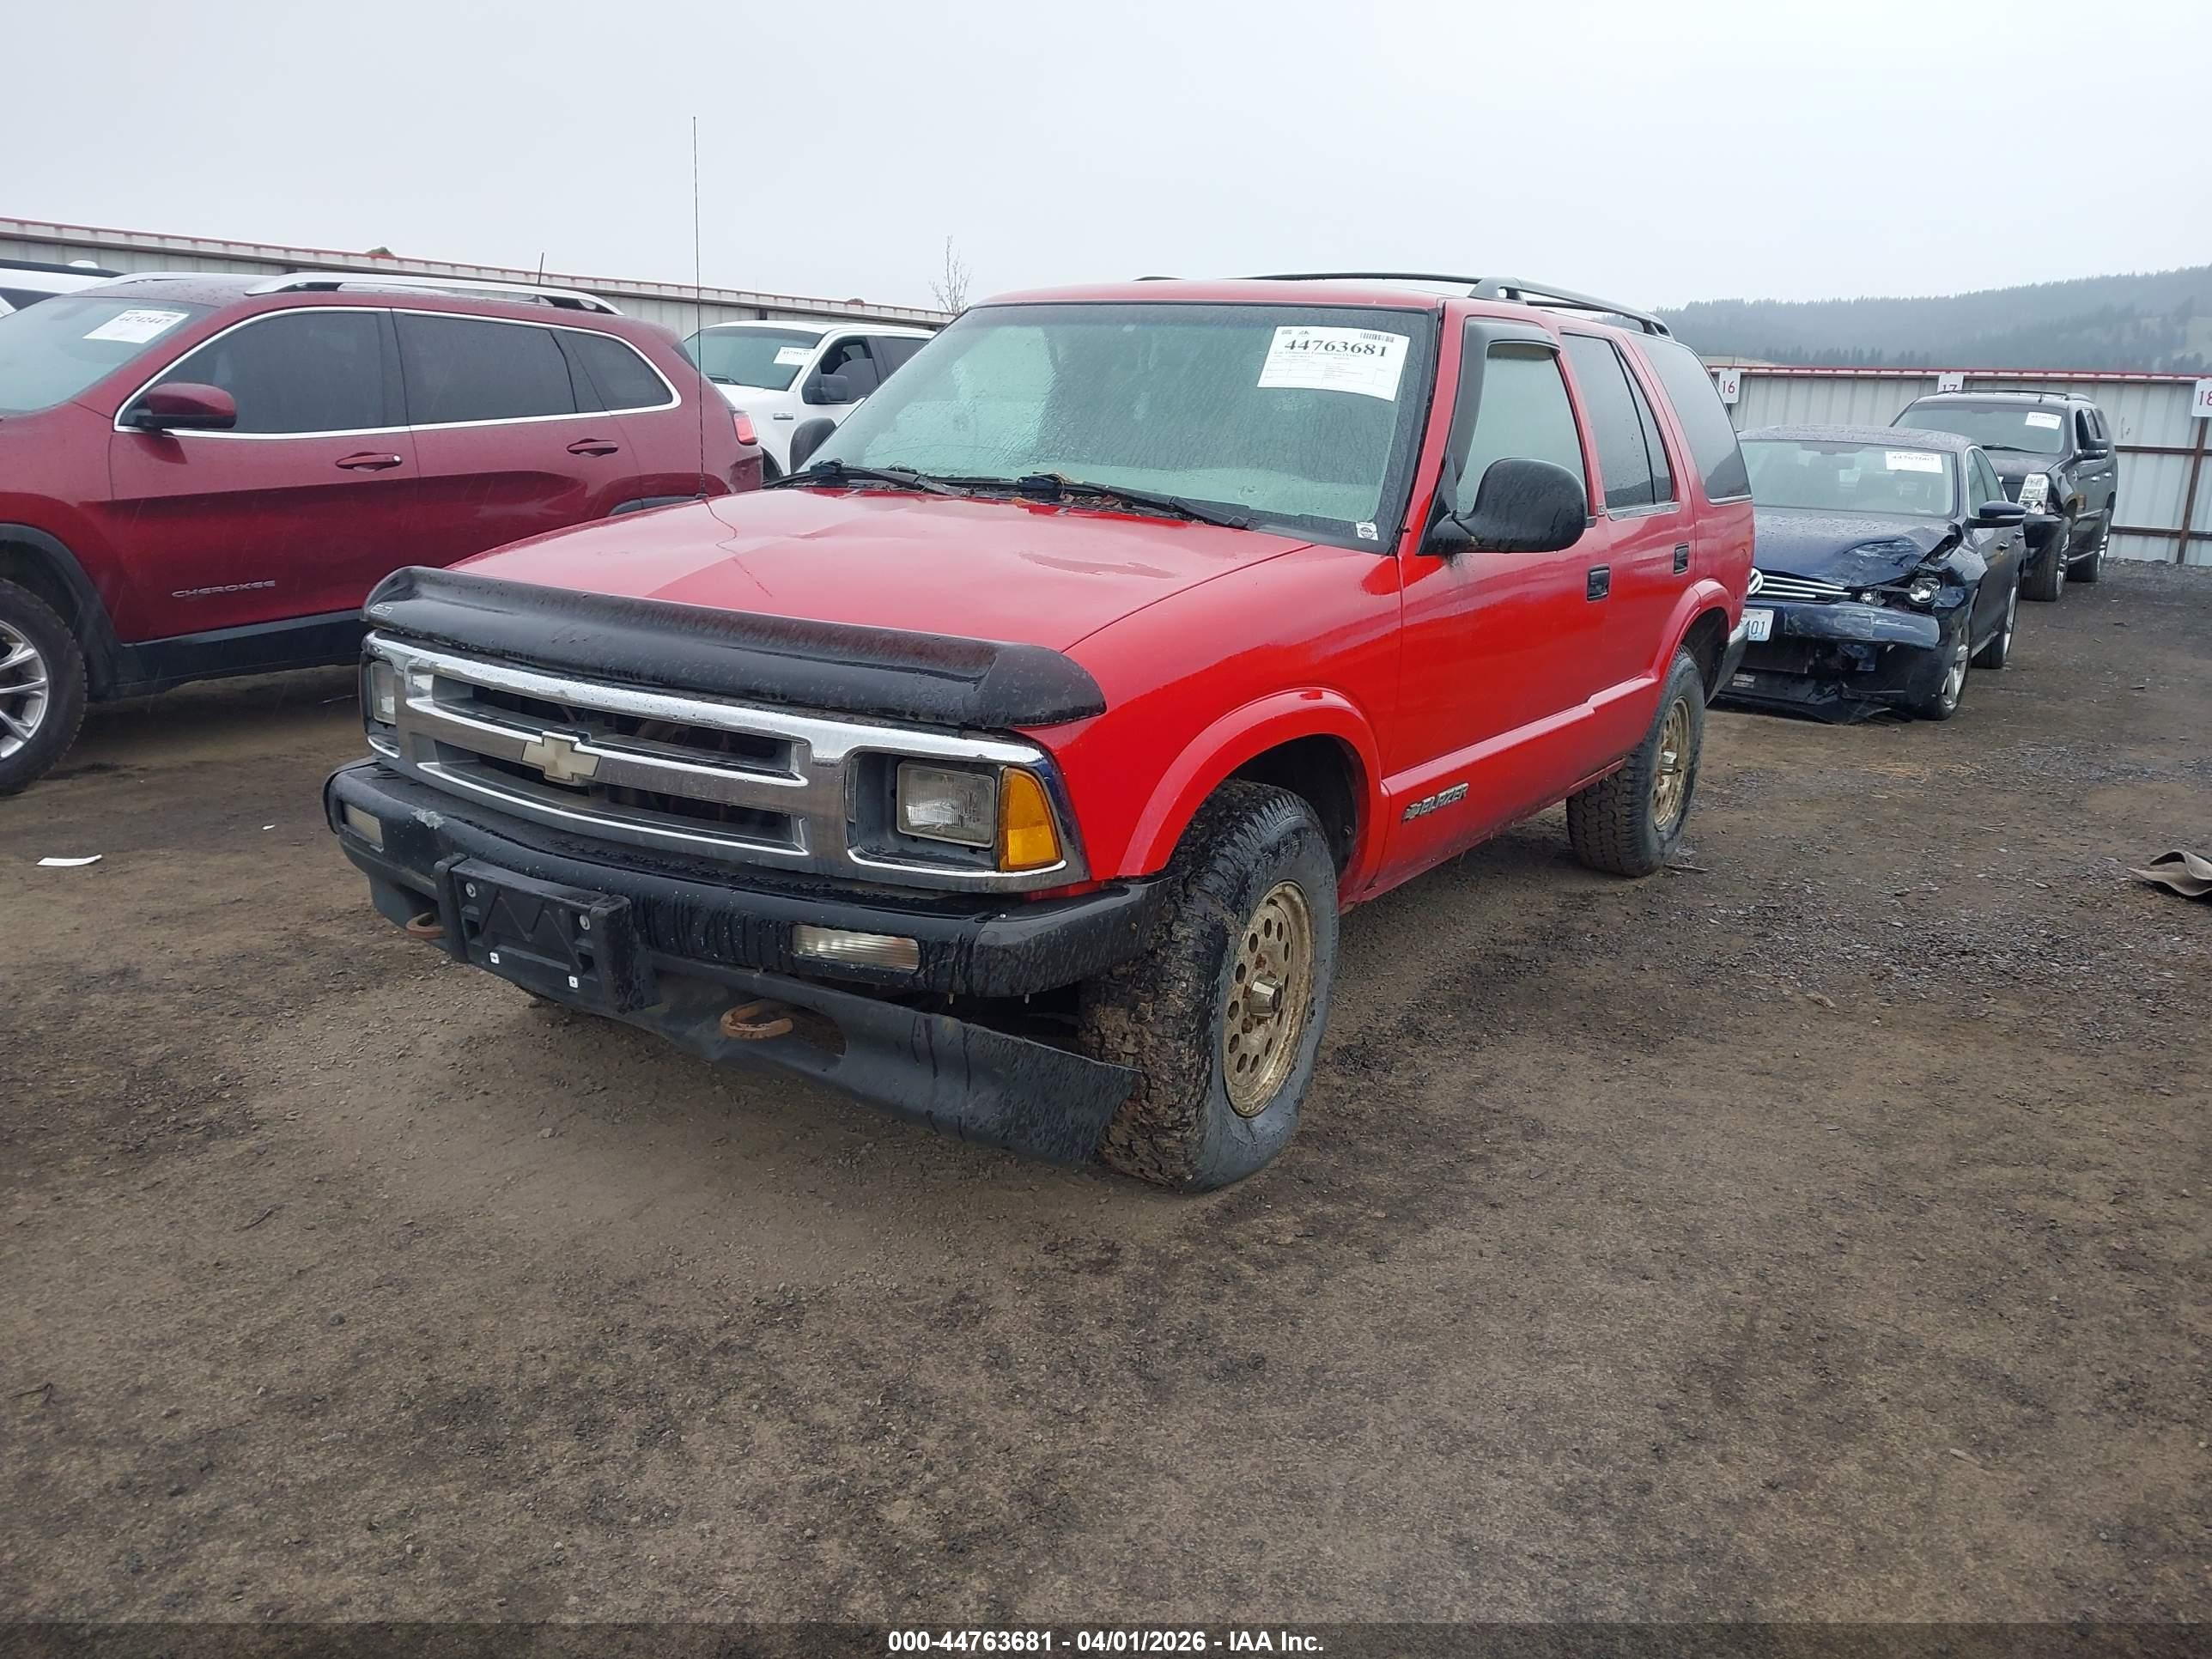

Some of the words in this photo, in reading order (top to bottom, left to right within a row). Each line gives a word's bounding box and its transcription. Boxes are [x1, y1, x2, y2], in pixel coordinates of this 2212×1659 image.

[1284, 339, 1388, 357] 44763681
[1723, 380, 1735, 394] 16
[172, 580, 276, 598] CHEROKEE
[1419, 782, 1469, 816] BLAZER
